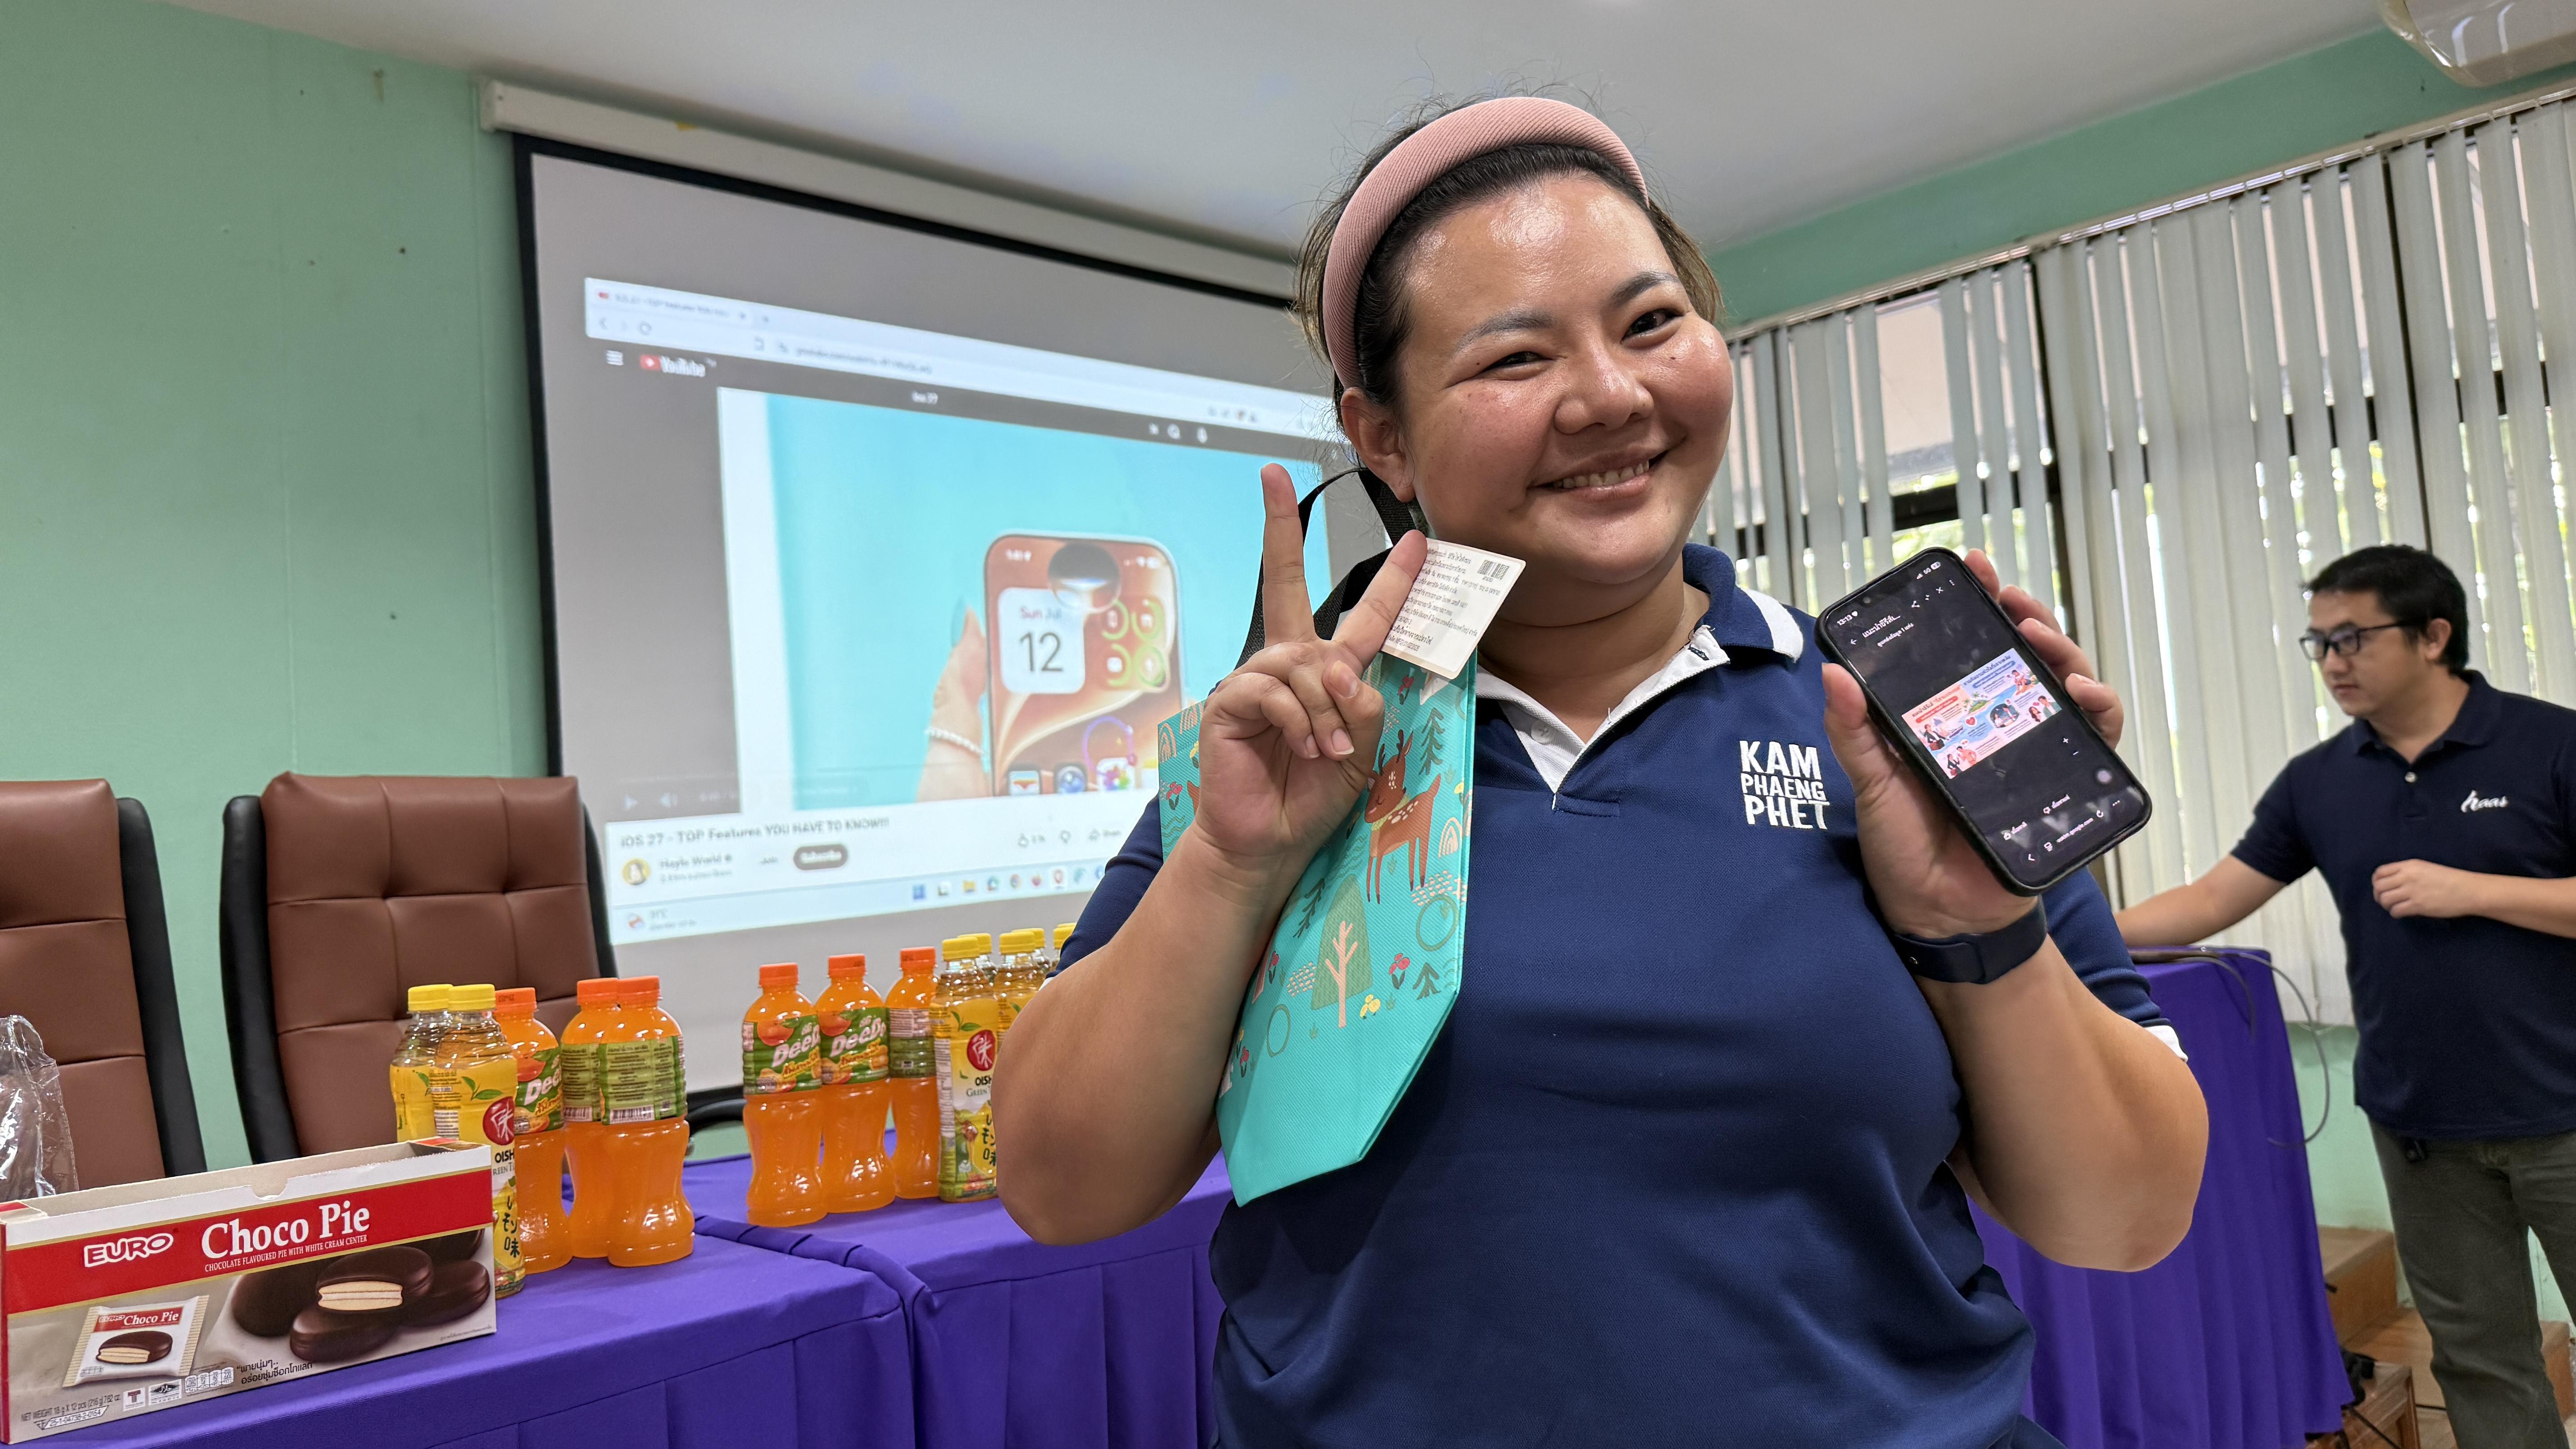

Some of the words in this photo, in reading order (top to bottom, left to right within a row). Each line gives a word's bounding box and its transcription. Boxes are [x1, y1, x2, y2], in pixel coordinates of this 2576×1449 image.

[661, 356, 706, 377] YouTube
[1020, 606, 1042, 619] Sun
[1019, 632, 1063, 672] 12
[1739, 740, 1822, 780] KAM
[1741, 773, 1826, 800] PHAENG
[1743, 794, 1830, 829] PHET
[621, 833, 644, 848] iOS
[647, 832, 663, 846] 27
[676, 829, 705, 844] TOP
[708, 826, 762, 840] Features
[764, 823, 790, 837] YOU
[792, 820, 824, 834] HAVE
[826, 819, 842, 832] TO
[692, 855, 722, 865] World
[975, 1075, 991, 1086] OISH
[495, 1148, 515, 1163] OISH
[493, 1165, 508, 1176] REEN
[202, 1218, 309, 1259] Choco
[319, 1200, 370, 1238] Pie
[84, 1233, 174, 1267] EURO
[205, 1258, 241, 1272] CHOCOLATE
[242, 1251, 276, 1265] FLAVOURED
[278, 1249, 287, 1258] PIE
[289, 1247, 304, 1256] WITH
[305, 1243, 323, 1253] WHITE
[325, 1238, 345, 1249] CREAM
[345, 1234, 368, 1245] CENTER
[124, 1314, 158, 1326] Choco
[161, 1311, 179, 1322] Pie
[21, 1412, 32, 1421] NET
[33, 1408, 53, 1419] WEIGHT
[78, 1402, 87, 1410] pcs
